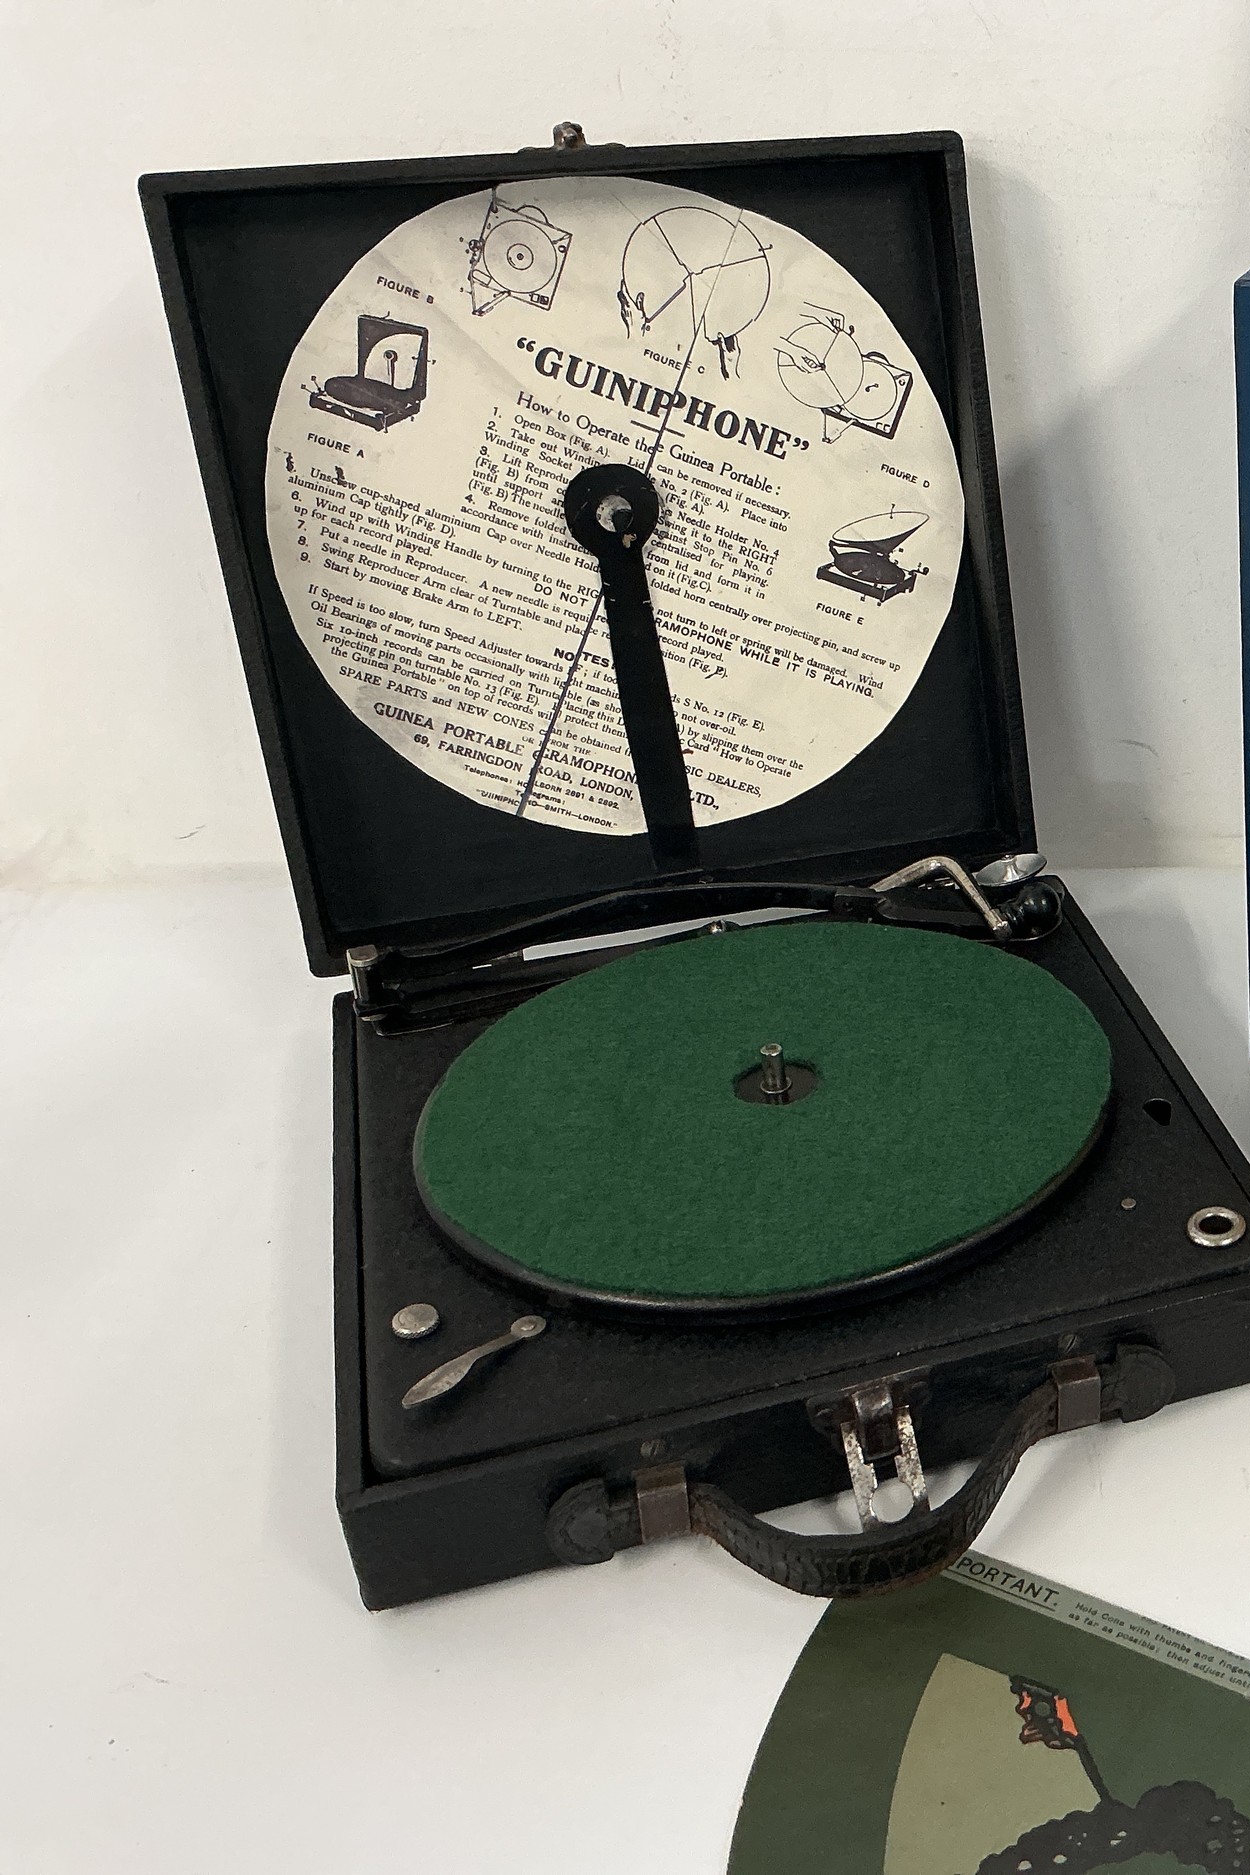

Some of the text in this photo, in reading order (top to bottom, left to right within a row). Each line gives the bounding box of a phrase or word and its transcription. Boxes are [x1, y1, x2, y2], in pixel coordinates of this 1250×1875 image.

[376, 275, 434, 304] FIGURE B
[642, 348, 705, 374] FIGURE C
[306, 432, 364, 458] FIGURE A
[484, 430, 573, 471] Winding Socket
[513, 413, 791, 520] Open Box removed necessary.
[516, 390, 553, 415] How
[575, 414, 630, 446] Operate
[668, 443, 714, 472] Guinea
[287, 474, 409, 522] aluminium tightly
[472, 469, 715, 557] until support Stop
[501, 452, 749, 544] Lift Needle Holder
[510, 427, 787, 532] Take Place into
[523, 473, 777, 565] from RIGHT
[922, 479, 930, 488] D
[320, 542, 541, 621] Swing Reproducer clear Turntable
[359, 486, 887, 665] cup-shaped aluminium over Needle folded horn centrally over projecting screw
[459, 505, 712, 593] accordance with (Fig.C).
[487, 499, 740, 590] Remove folded from form
[649, 538, 769, 588] centralised playing.
[315, 496, 884, 690] Wind with Winding Handle turning turn left spring will damaged. Wind
[320, 587, 563, 672] Speed slow, turn Speed Adjuster towards
[322, 557, 522, 631] Start moving Brake LEFT.
[329, 516, 874, 698] each record played. DO WHILE IT IS PLAYING.
[351, 539, 724, 662] needle Reproducer. needle played.
[815, 602, 864, 625] FIGURE E
[321, 632, 791, 778] projecting turntable this Card Operate
[329, 605, 736, 736] Bearings moving parts occasionally with over-oil.
[338, 625, 787, 765] 10-inch records carried slipping them over
[351, 651, 599, 730] Guinea records protect
[338, 665, 761, 798] SPARE PARTS CONES obtained DEALERS,
[372, 701, 434, 730] GUINEA
[442, 721, 525, 756] PORTABLE
[437, 739, 523, 772] FARRINGDON
[579, 776, 633, 801] LONDON,
